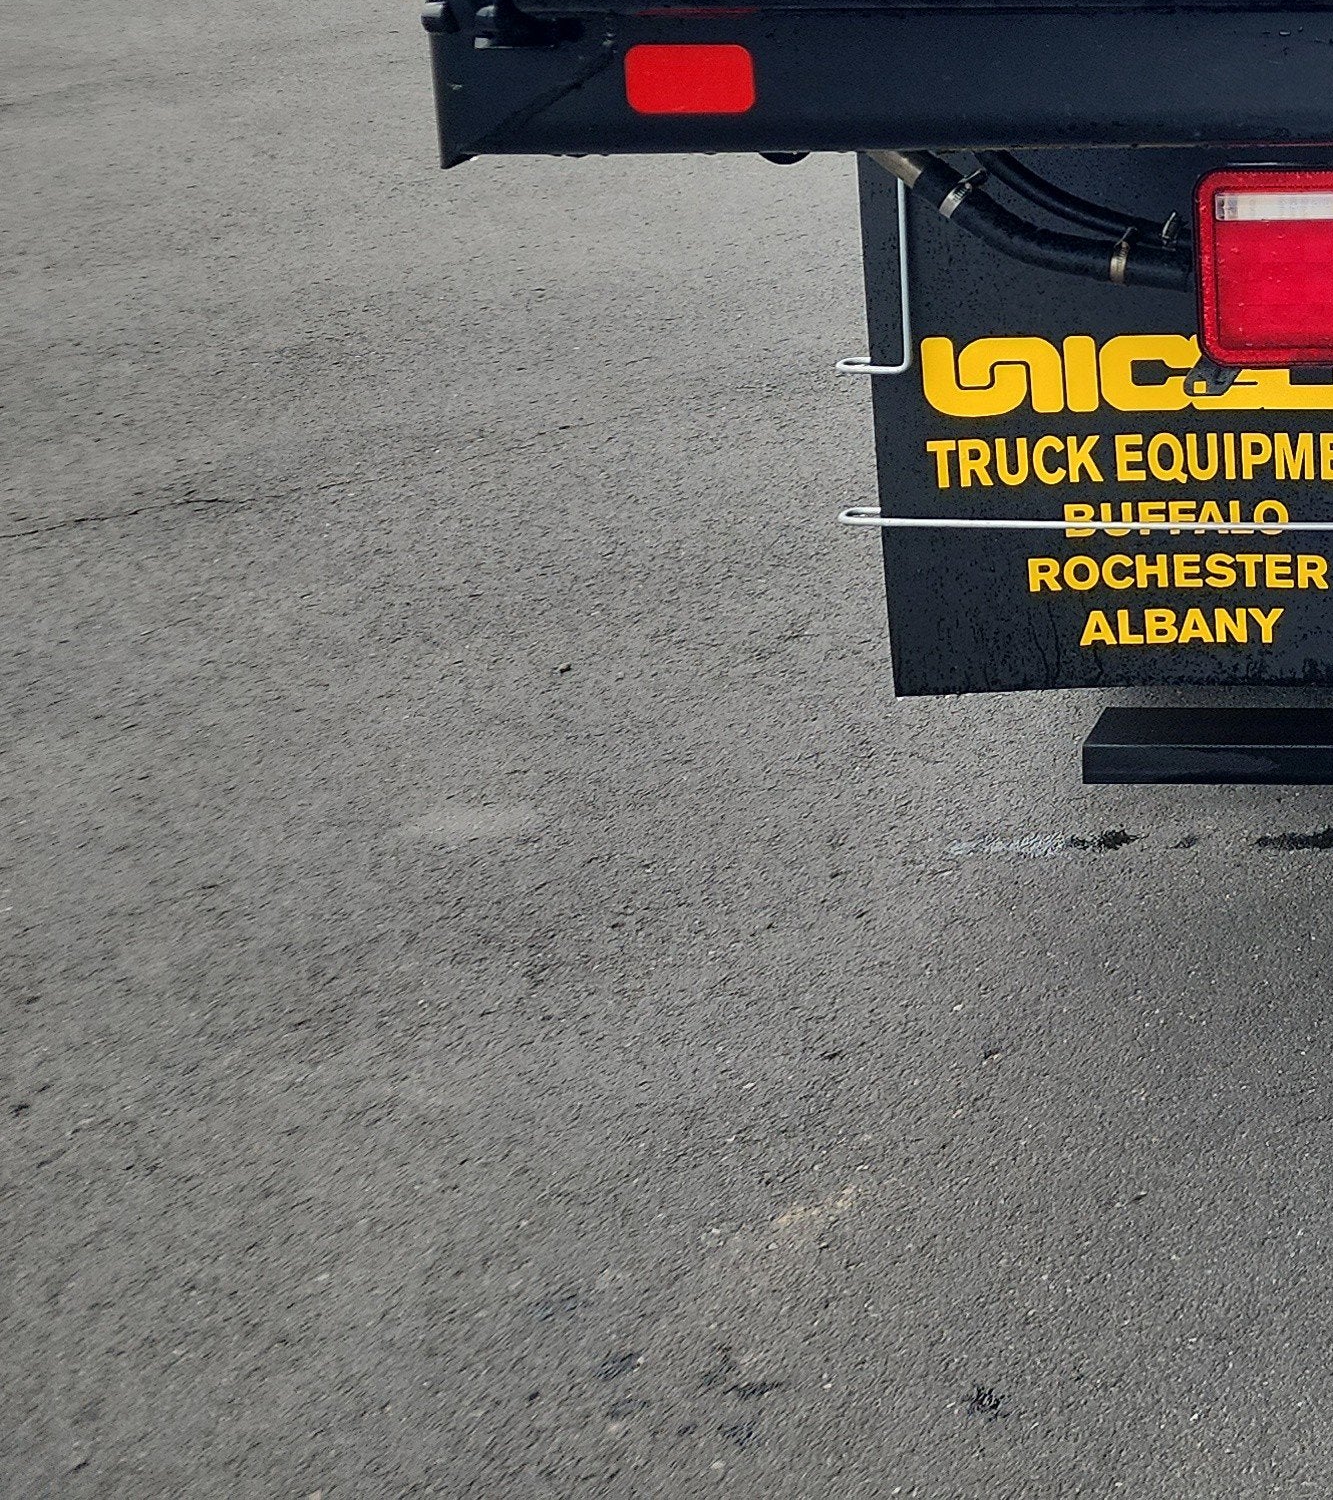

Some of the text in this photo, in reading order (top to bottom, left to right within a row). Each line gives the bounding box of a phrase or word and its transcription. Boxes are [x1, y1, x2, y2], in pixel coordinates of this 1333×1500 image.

[926, 434, 1104, 489] TRUCK
[1063, 499, 1290, 538] BUFFALO
[1028, 552, 1328, 593] ROCHESTER
[1079, 607, 1284, 647] ALBANY
